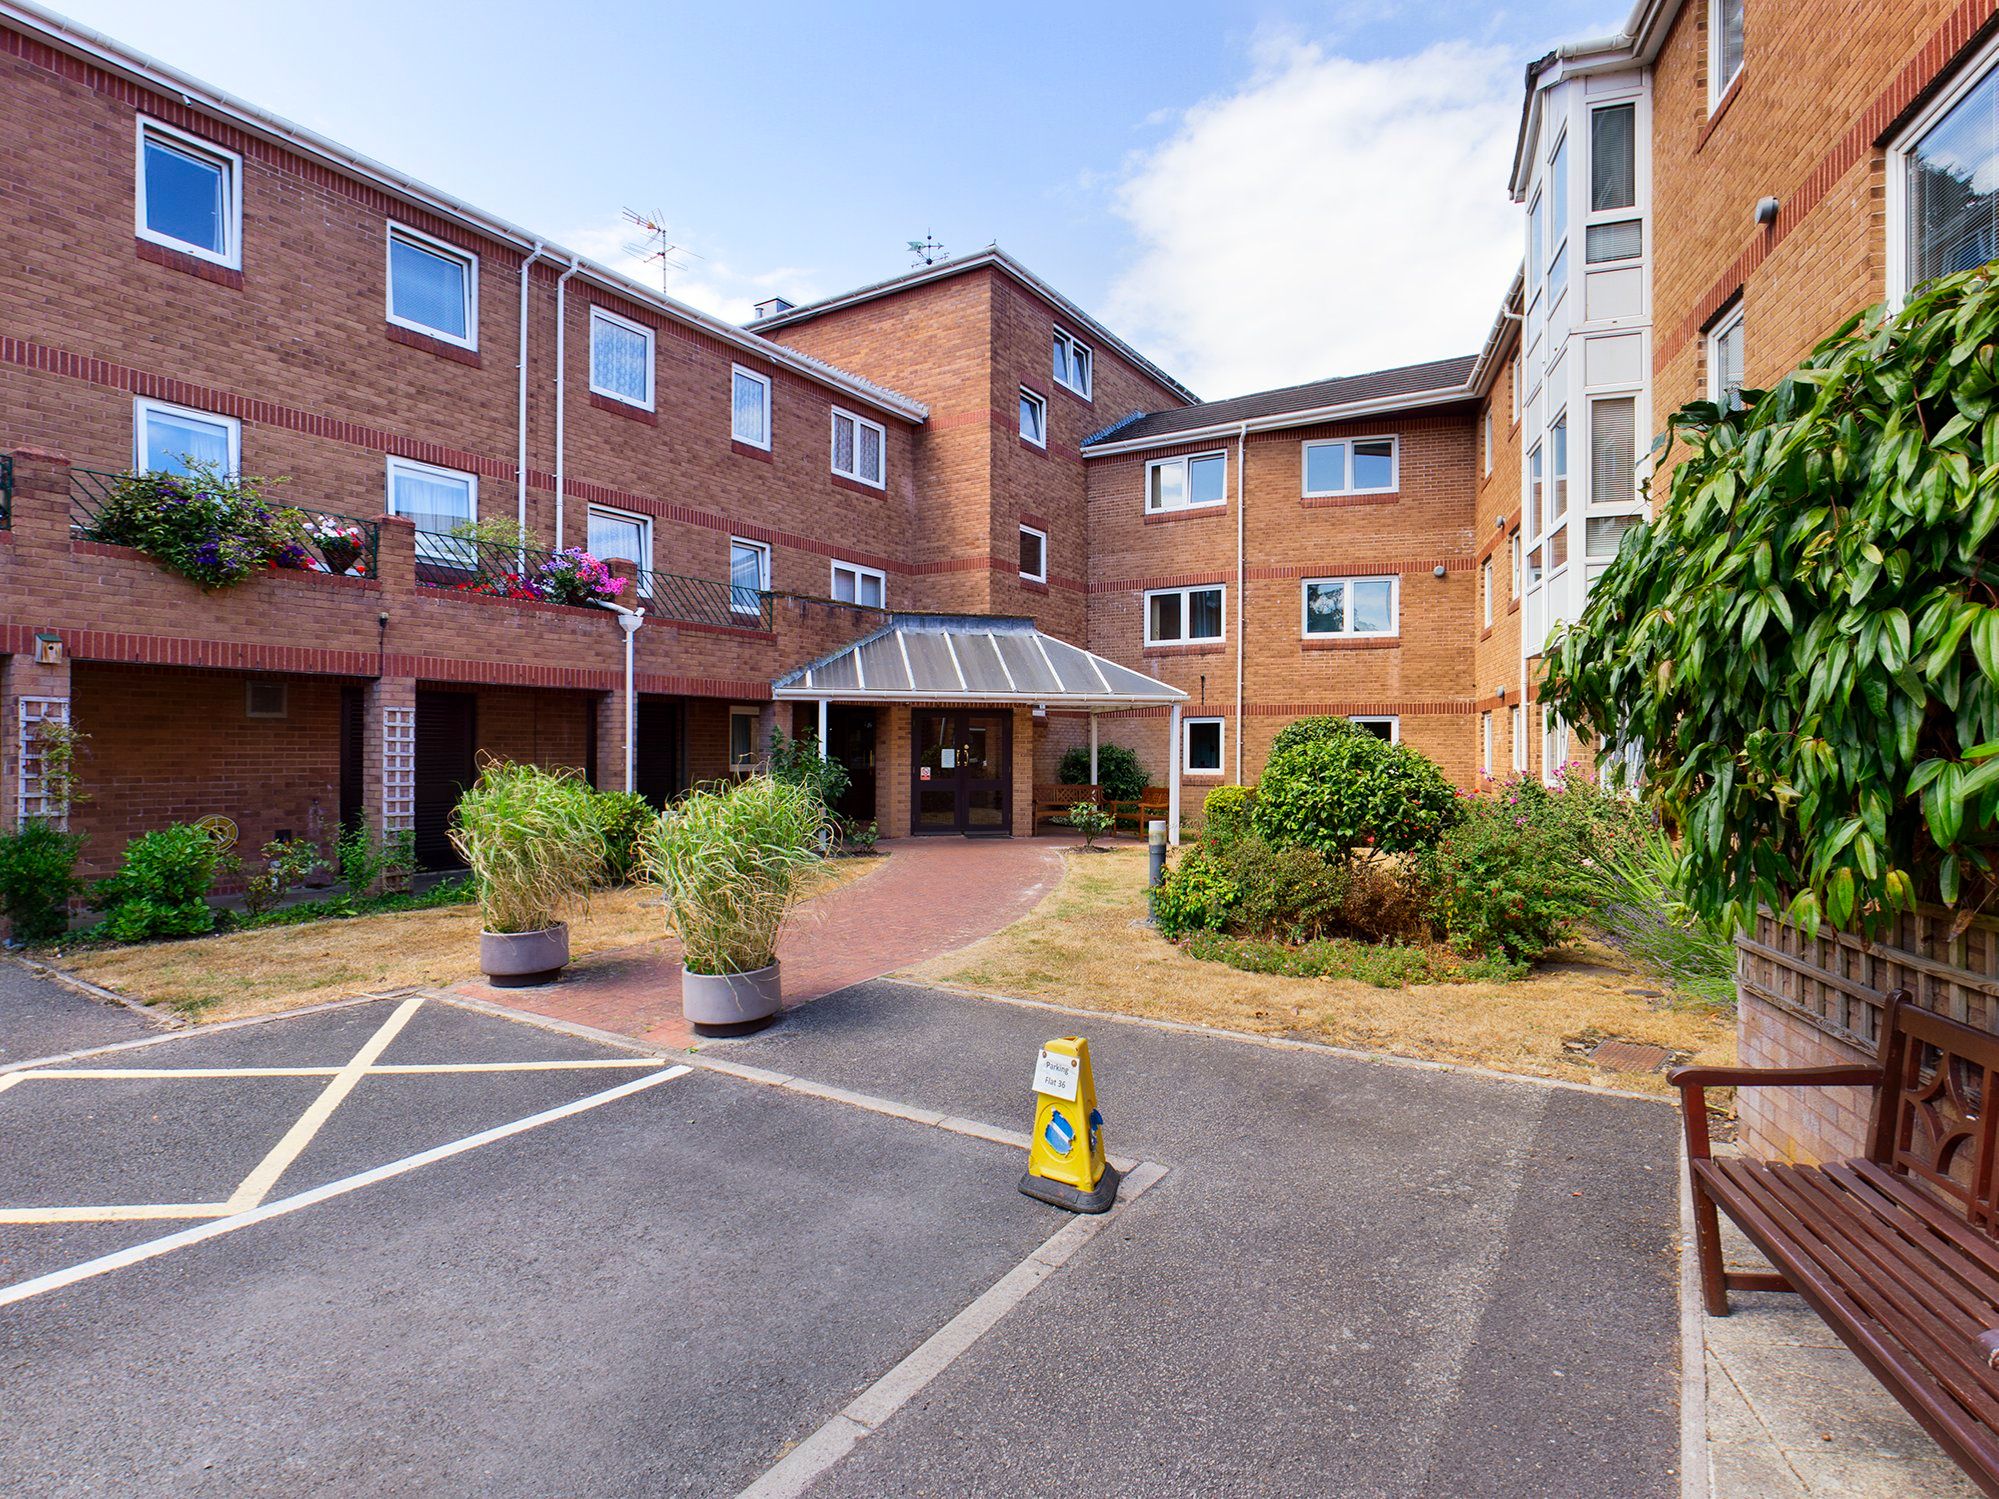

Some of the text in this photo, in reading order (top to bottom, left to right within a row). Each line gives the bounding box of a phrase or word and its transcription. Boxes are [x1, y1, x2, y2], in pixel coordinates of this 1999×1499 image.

[1045, 1061, 1070, 1076] Parking
[1044, 1076, 1066, 1089] Flat 36
